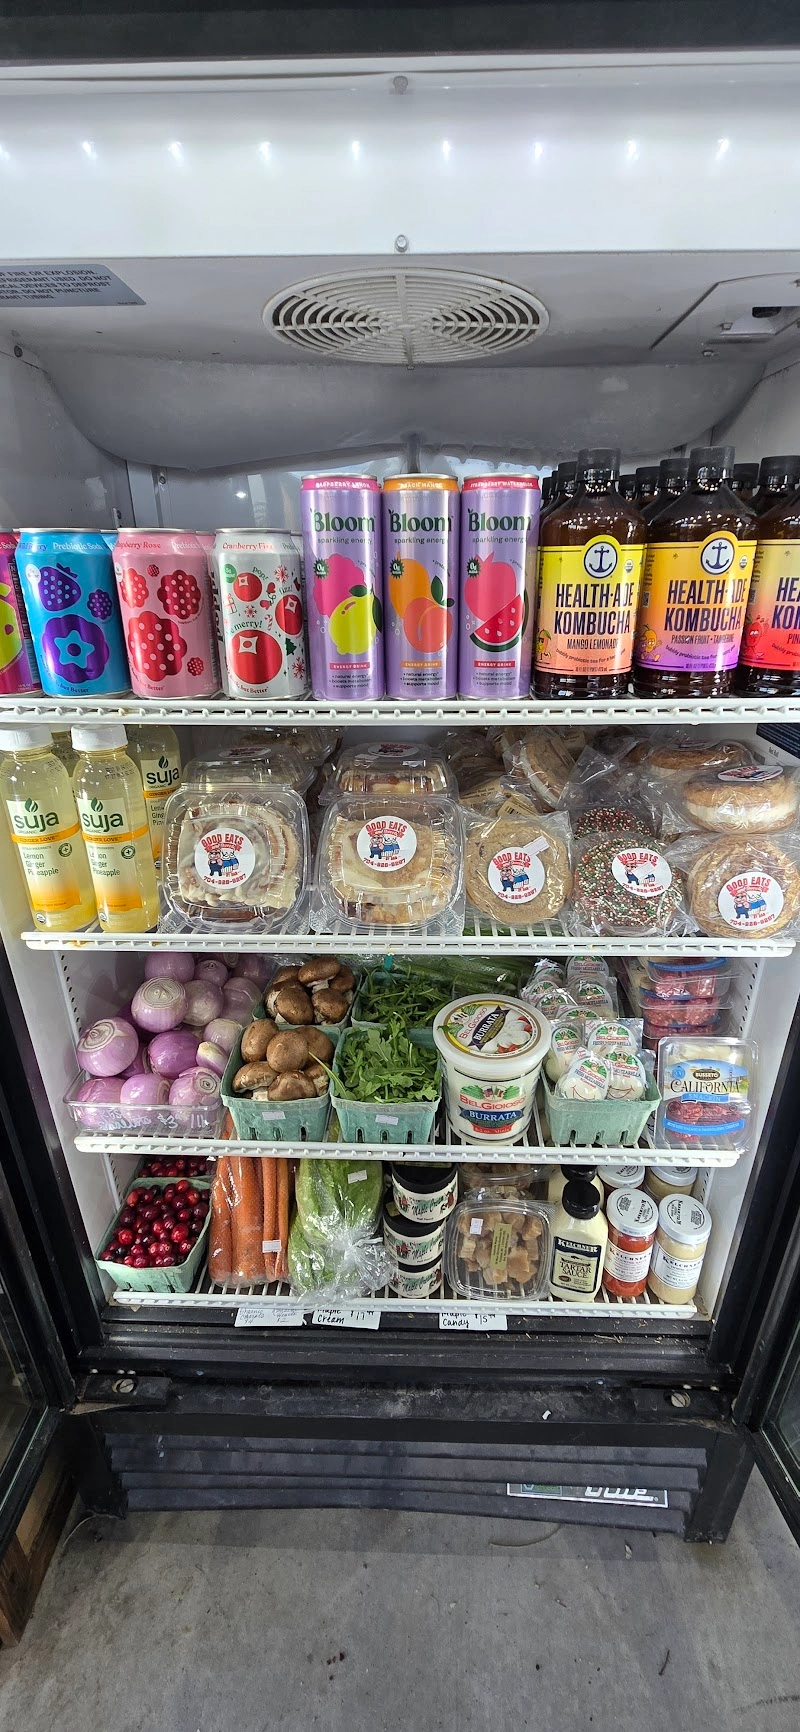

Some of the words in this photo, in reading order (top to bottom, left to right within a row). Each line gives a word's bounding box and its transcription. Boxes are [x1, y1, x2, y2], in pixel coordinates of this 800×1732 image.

[314, 512, 375, 532] Bloom
[390, 512, 452, 532] Bloom
[468, 512, 531, 532] Bloom
[223, 542, 257, 551] Cranberry
[252, 566, 268, 580] pop!
[554, 610, 631, 635] KOMBUCHA
[664, 606, 742, 631] KOMBUCHA
[234, 620, 262, 631] merry!
[567, 639, 588, 649] MANGO
[590, 638, 618, 649] LEMONAD
[146, 768, 180, 785] suja
[14, 812, 59, 832] suja
[82, 813, 123, 832] suja
[366, 821, 386, 832] GOOD
[389, 821, 407, 832] EATS
[201, 834, 222, 847] GOOD
[225, 834, 244, 845] EATS
[493, 853, 512, 865] GOOD
[515, 852, 530, 862] EATS
[617, 853, 636, 861] GOOD
[640, 853, 658, 862] EATS
[26, 861, 45, 869] Giger
[28, 868, 59, 876] Pieapple
[726, 878, 748, 892] GOOD
[751, 877, 771, 886] EATS
[473, 1013, 499, 1040] BURRATA
[670, 1079, 740, 1092] CALIFORNIA
[470, 1111, 516, 1121] BURRATA
[318, 1314, 344, 1324] Cream
[443, 1319, 469, 1328] Candy
